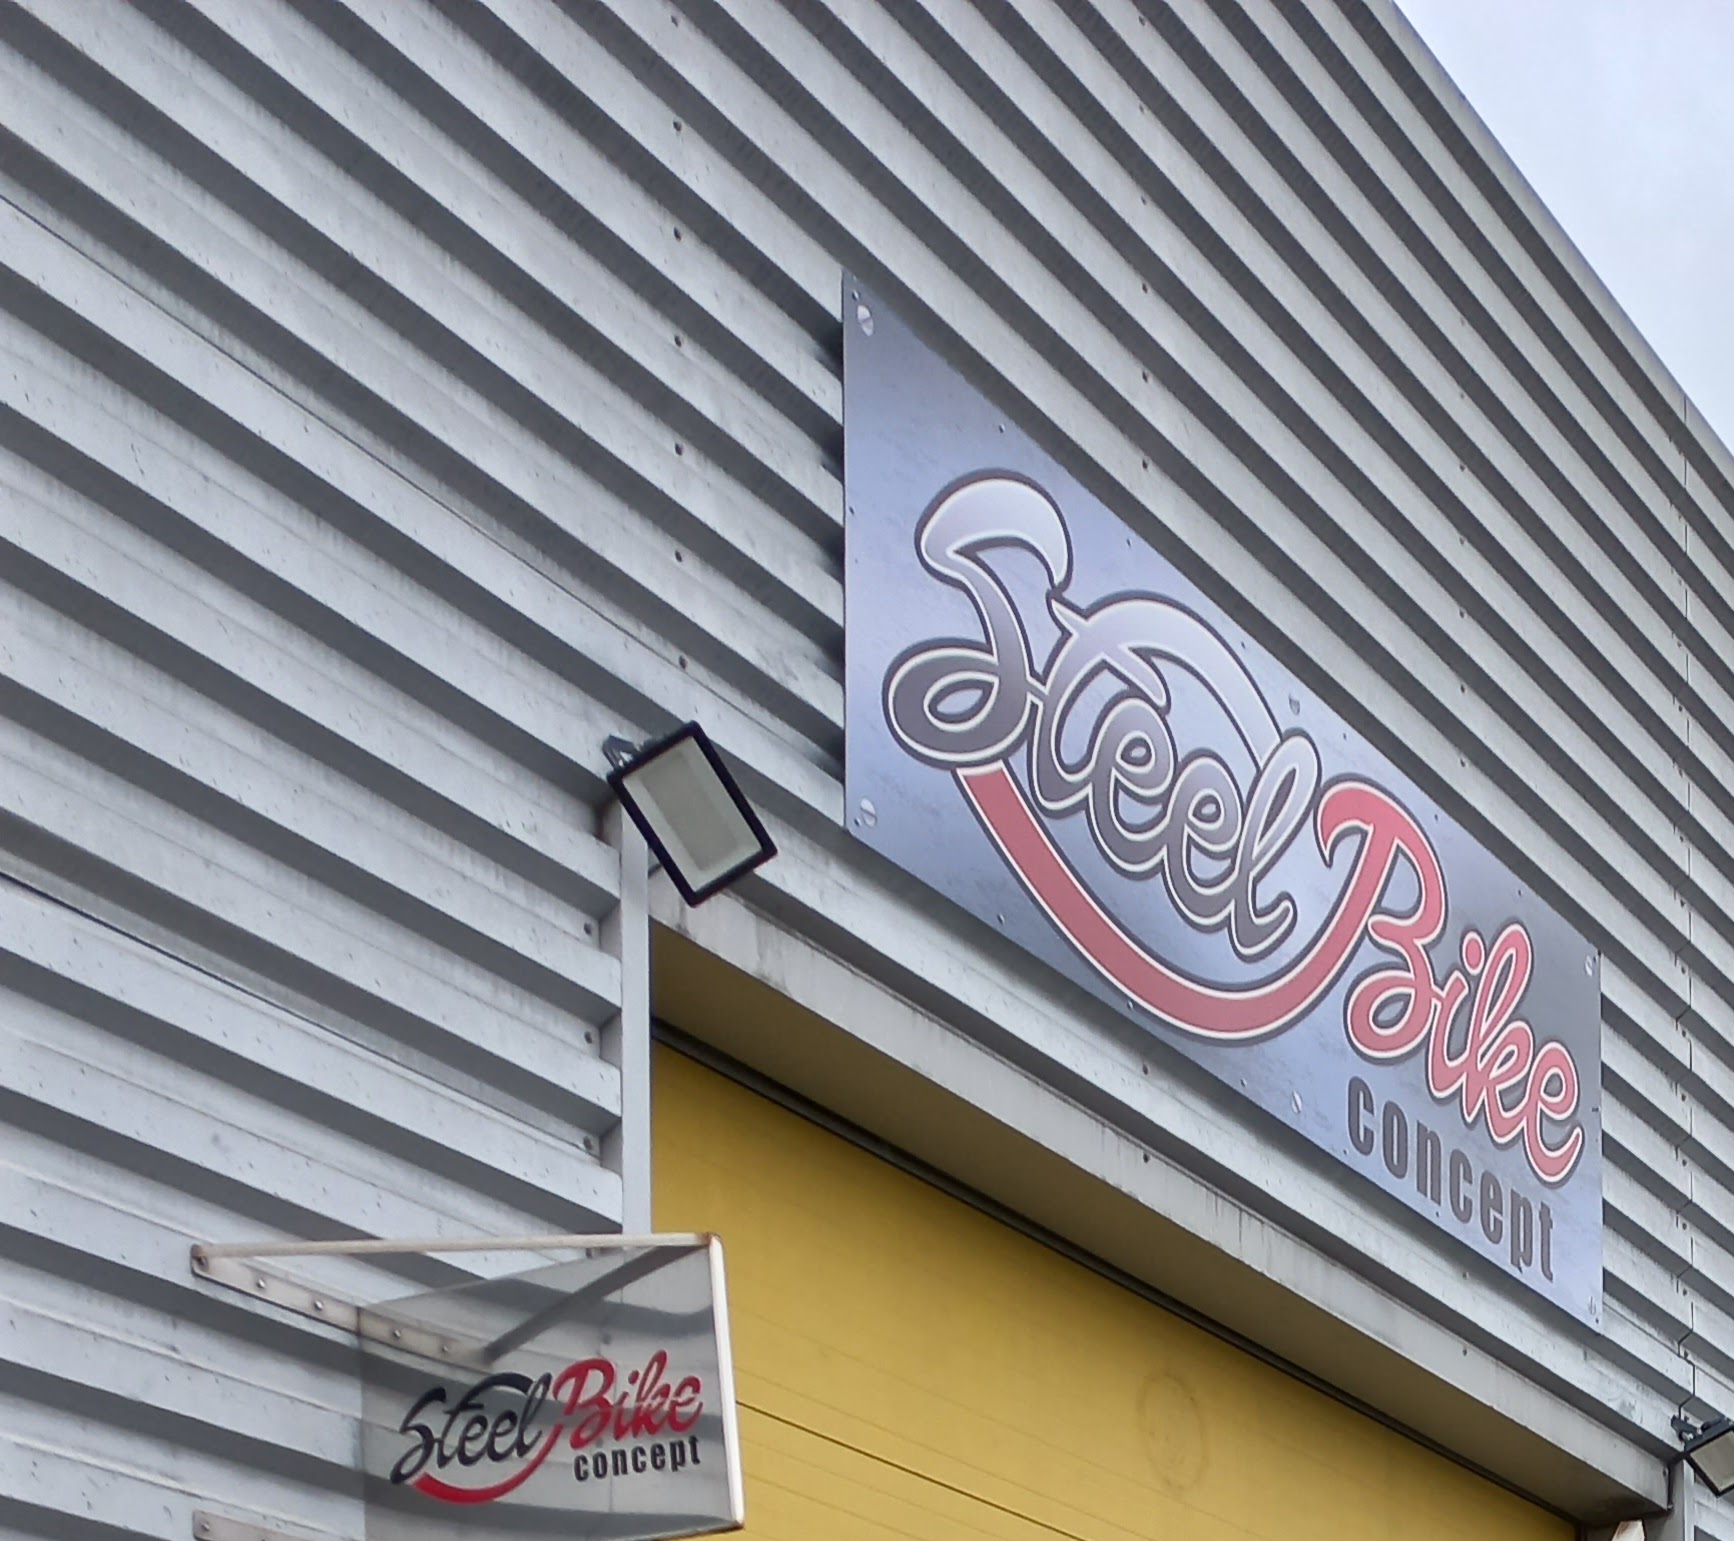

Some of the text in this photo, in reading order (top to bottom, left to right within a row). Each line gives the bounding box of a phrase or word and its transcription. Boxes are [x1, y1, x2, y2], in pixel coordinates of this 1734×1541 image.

[883, 466, 1585, 1186] Steel Bike
[1346, 1076, 1554, 1281] concept
[391, 1349, 704, 1484] Steel Bike
[573, 1435, 701, 1482] concept
